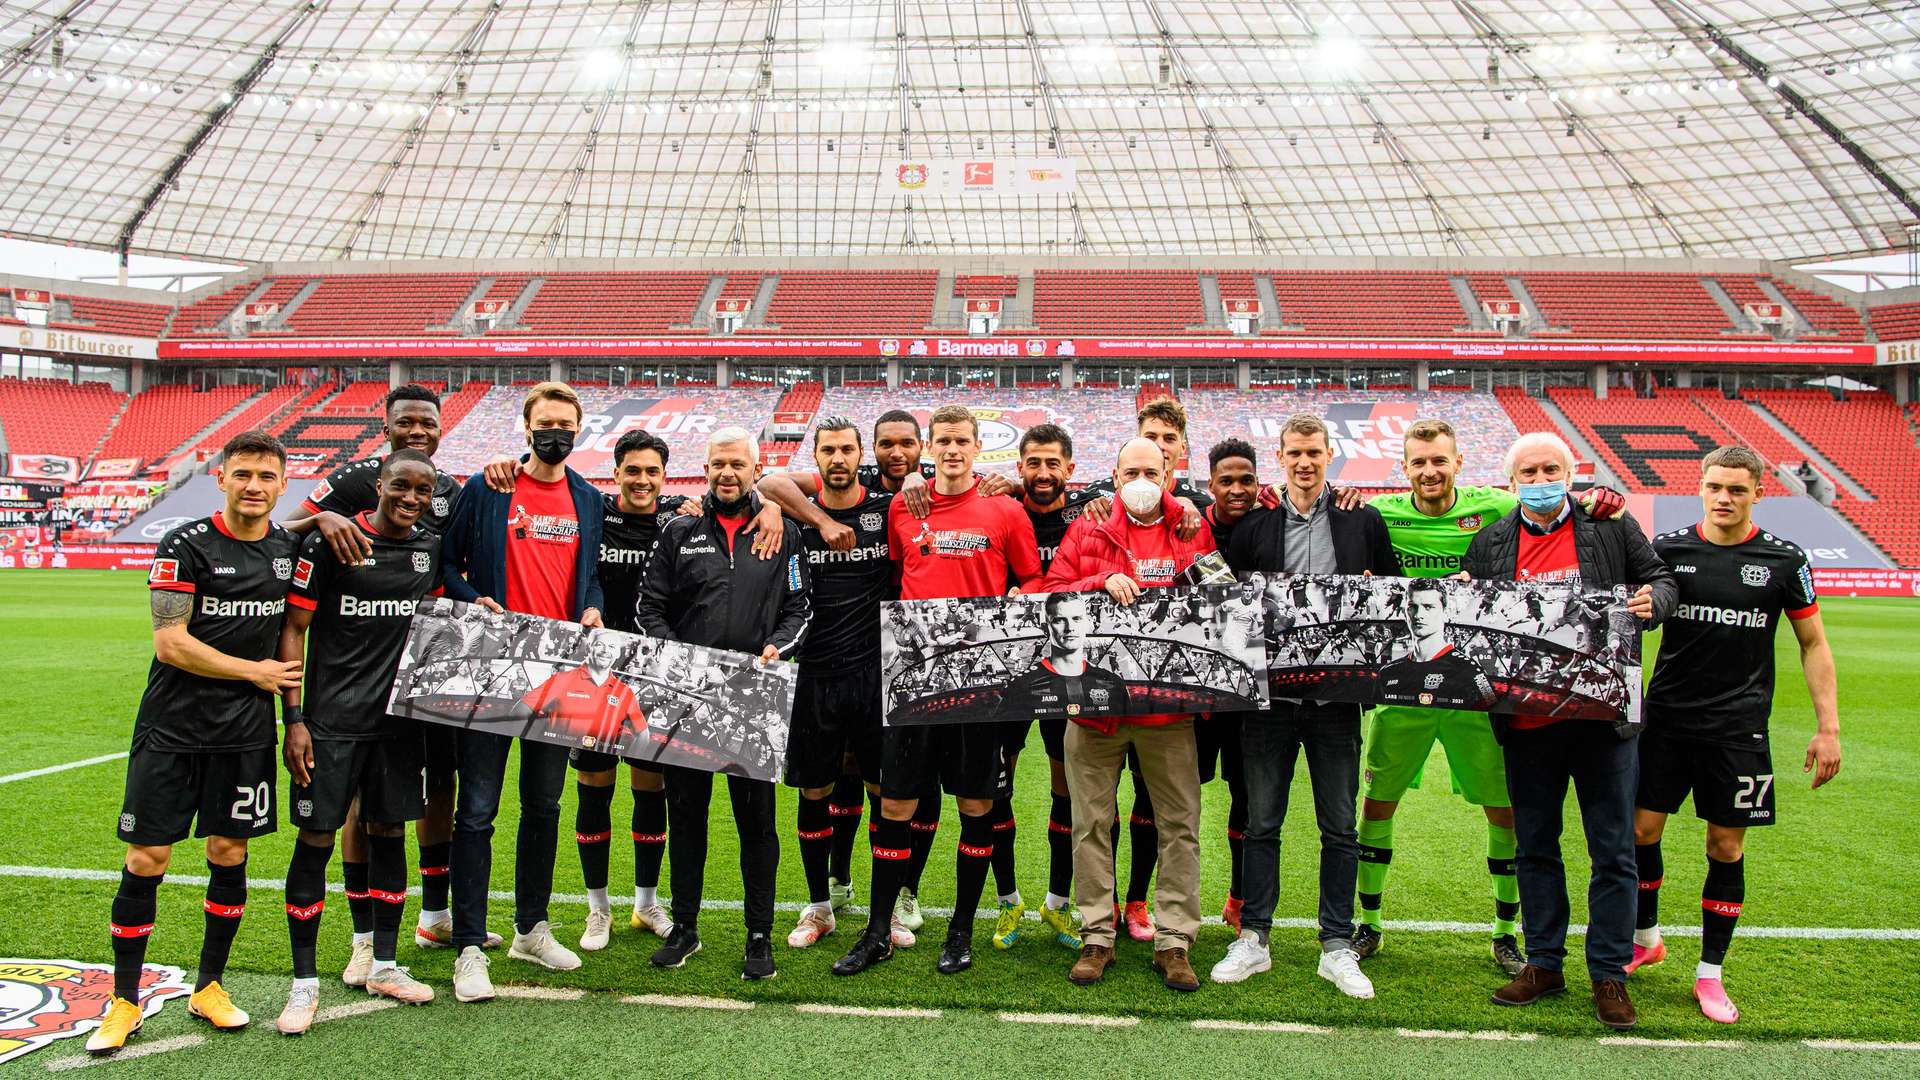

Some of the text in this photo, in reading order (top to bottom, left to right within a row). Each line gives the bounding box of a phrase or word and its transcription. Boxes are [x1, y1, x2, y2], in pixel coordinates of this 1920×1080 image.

[46, 332, 134, 356] Bitburger
[938, 339, 1018, 356] Barmenia
[613, 412, 717, 433] FÜR
[605, 515, 623, 524] JAKO
[600, 543, 647, 564] Barm
[680, 545, 716, 555] Barmenia
[806, 542, 889, 564] armenia
[1392, 551, 1463, 569] Barme
[214, 566, 236, 574] JAKO
[1674, 565, 1696, 573] JAKO
[1672, 603, 1769, 629] armenia
[1734, 774, 1773, 809] 27
[231, 781, 270, 820] 20
[1750, 810, 1770, 818] JAKO
[252, 816, 269, 828] JAKO
[961, 846, 986, 855] JAKO
[288, 905, 318, 918] JAKO
[1713, 904, 1741, 914] JAKO
